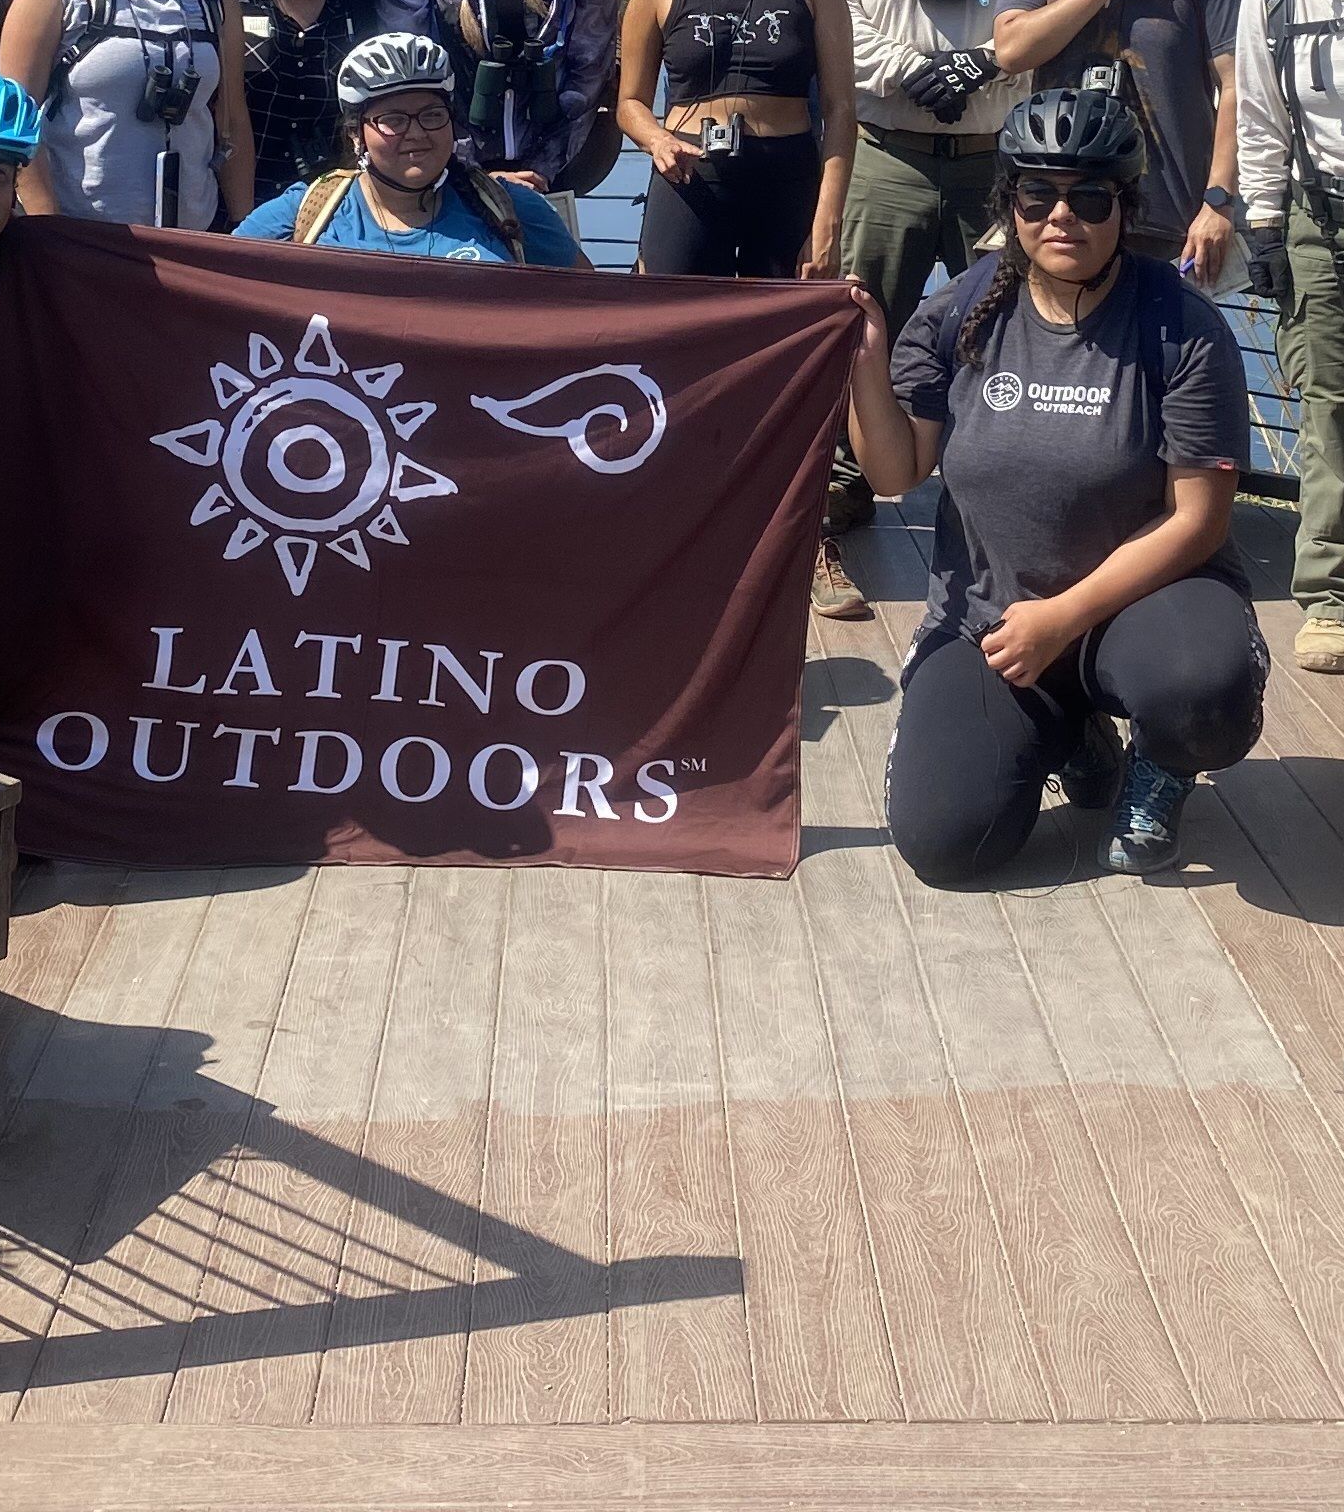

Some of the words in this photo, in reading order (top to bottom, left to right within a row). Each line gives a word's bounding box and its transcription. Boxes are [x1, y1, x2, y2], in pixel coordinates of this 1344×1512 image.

[938, 64, 966, 93] FOX
[1027, 382, 1111, 404] OUTDOOR
[1033, 401, 1102, 416] OUTREACH
[141, 626, 588, 718] LATINO
[36, 710, 680, 826] OUTDOORS
